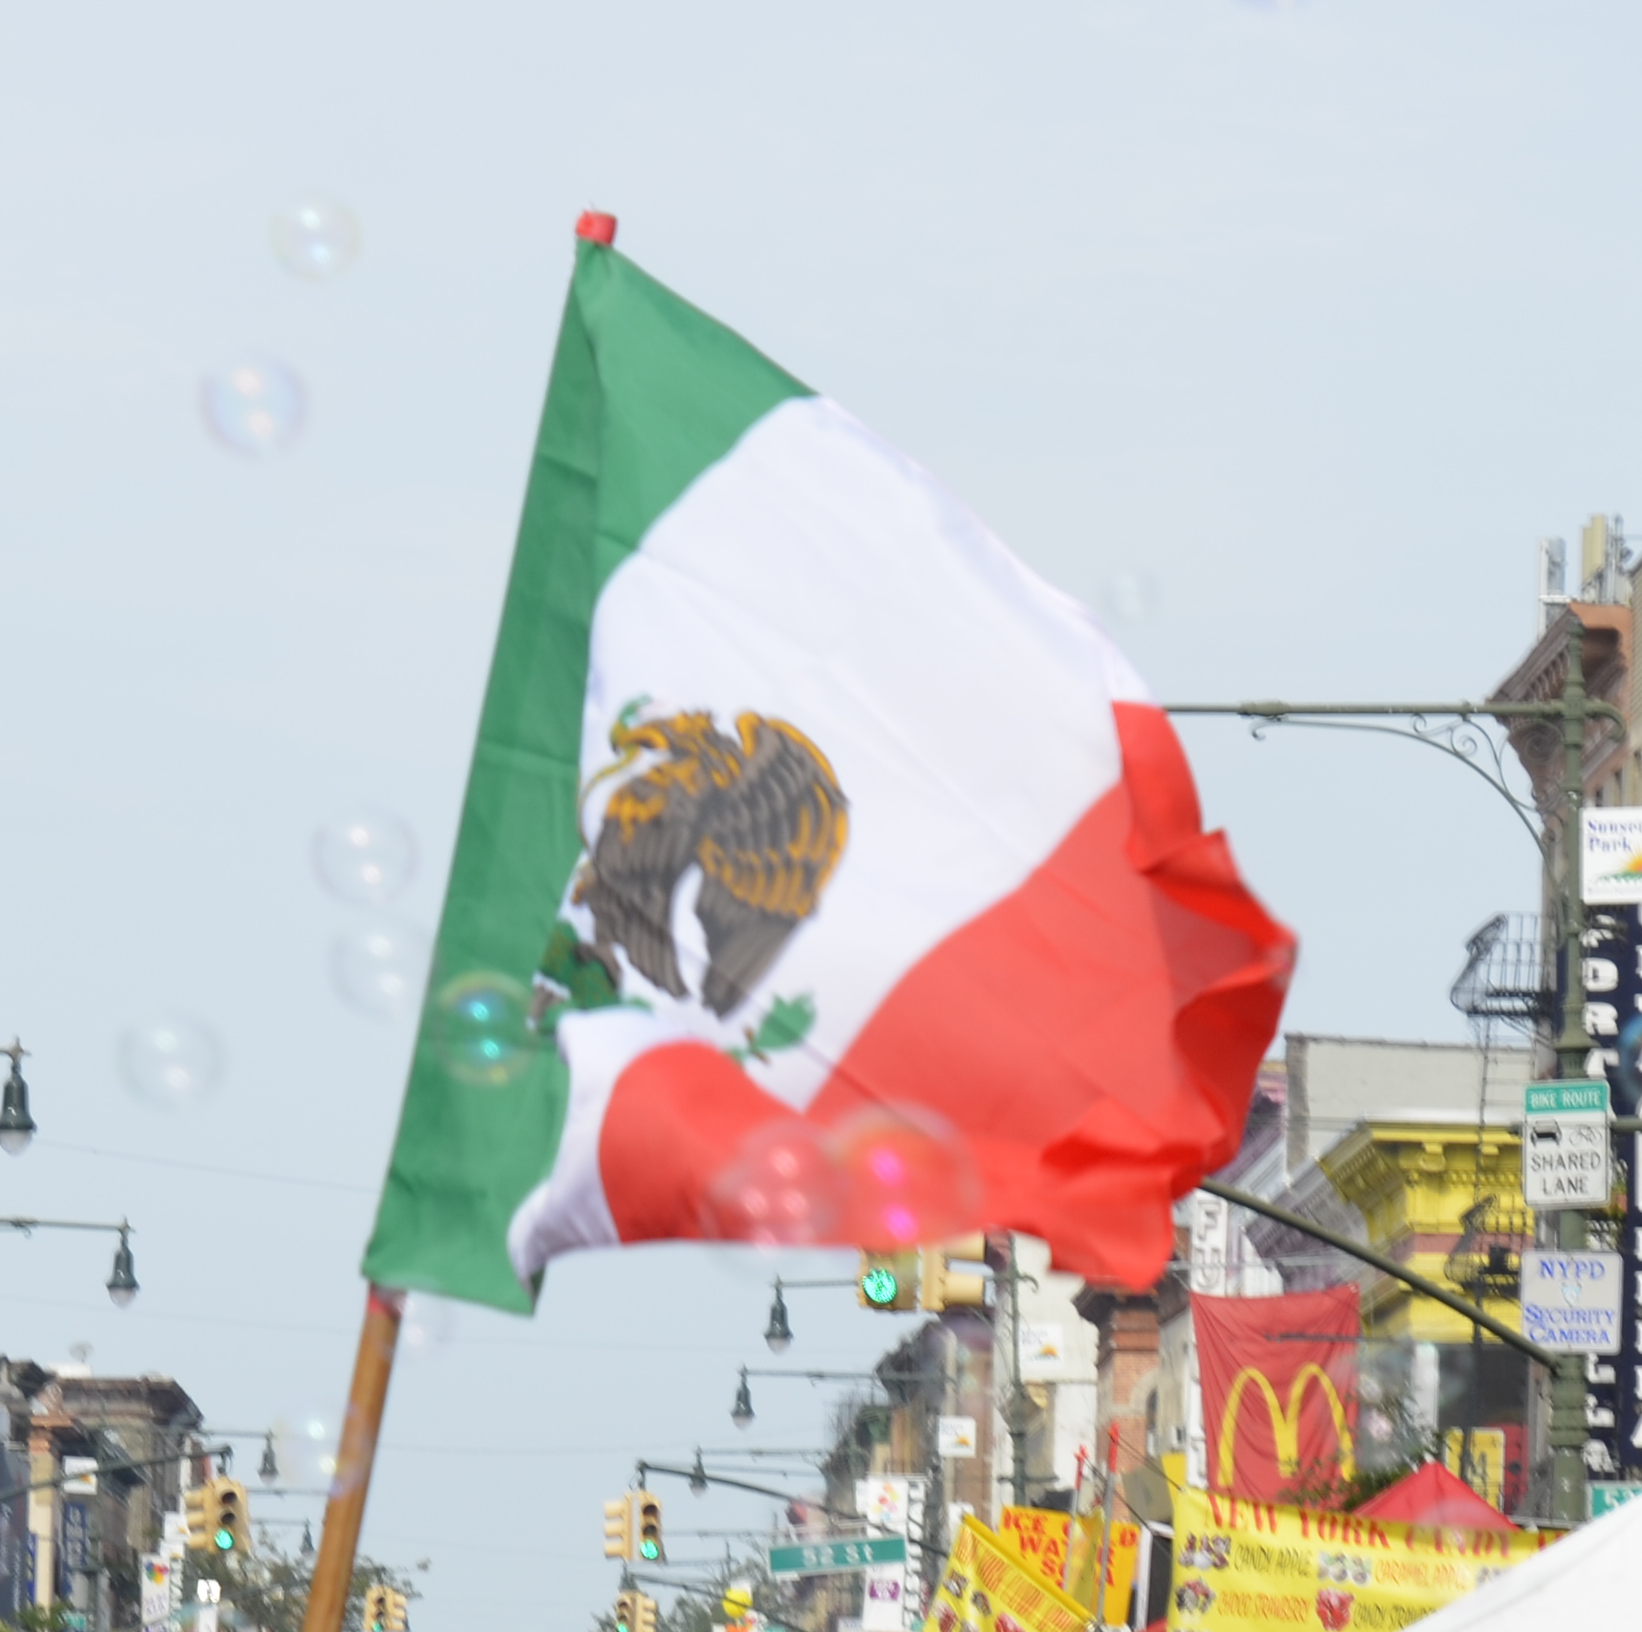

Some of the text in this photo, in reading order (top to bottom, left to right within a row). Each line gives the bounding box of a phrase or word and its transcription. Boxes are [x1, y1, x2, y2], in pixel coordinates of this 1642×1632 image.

[1588, 836, 1633, 853] Park
[1531, 1088, 1602, 1109] BIKE ROUTE
[1531, 1151, 1601, 1173] SHARED
[1542, 1177, 1590, 1196] LANE
[1539, 1259, 1606, 1280] NYPD
[1524, 1304, 1616, 1327] SECURITY
[1528, 1323, 1612, 1345] CAMERA
[1207, 1492, 1279, 1534] NEW
[1299, 1506, 1391, 1549] YORK
[802, 1547, 835, 1568] 52
[1233, 1544, 1272, 1574] CANDY
